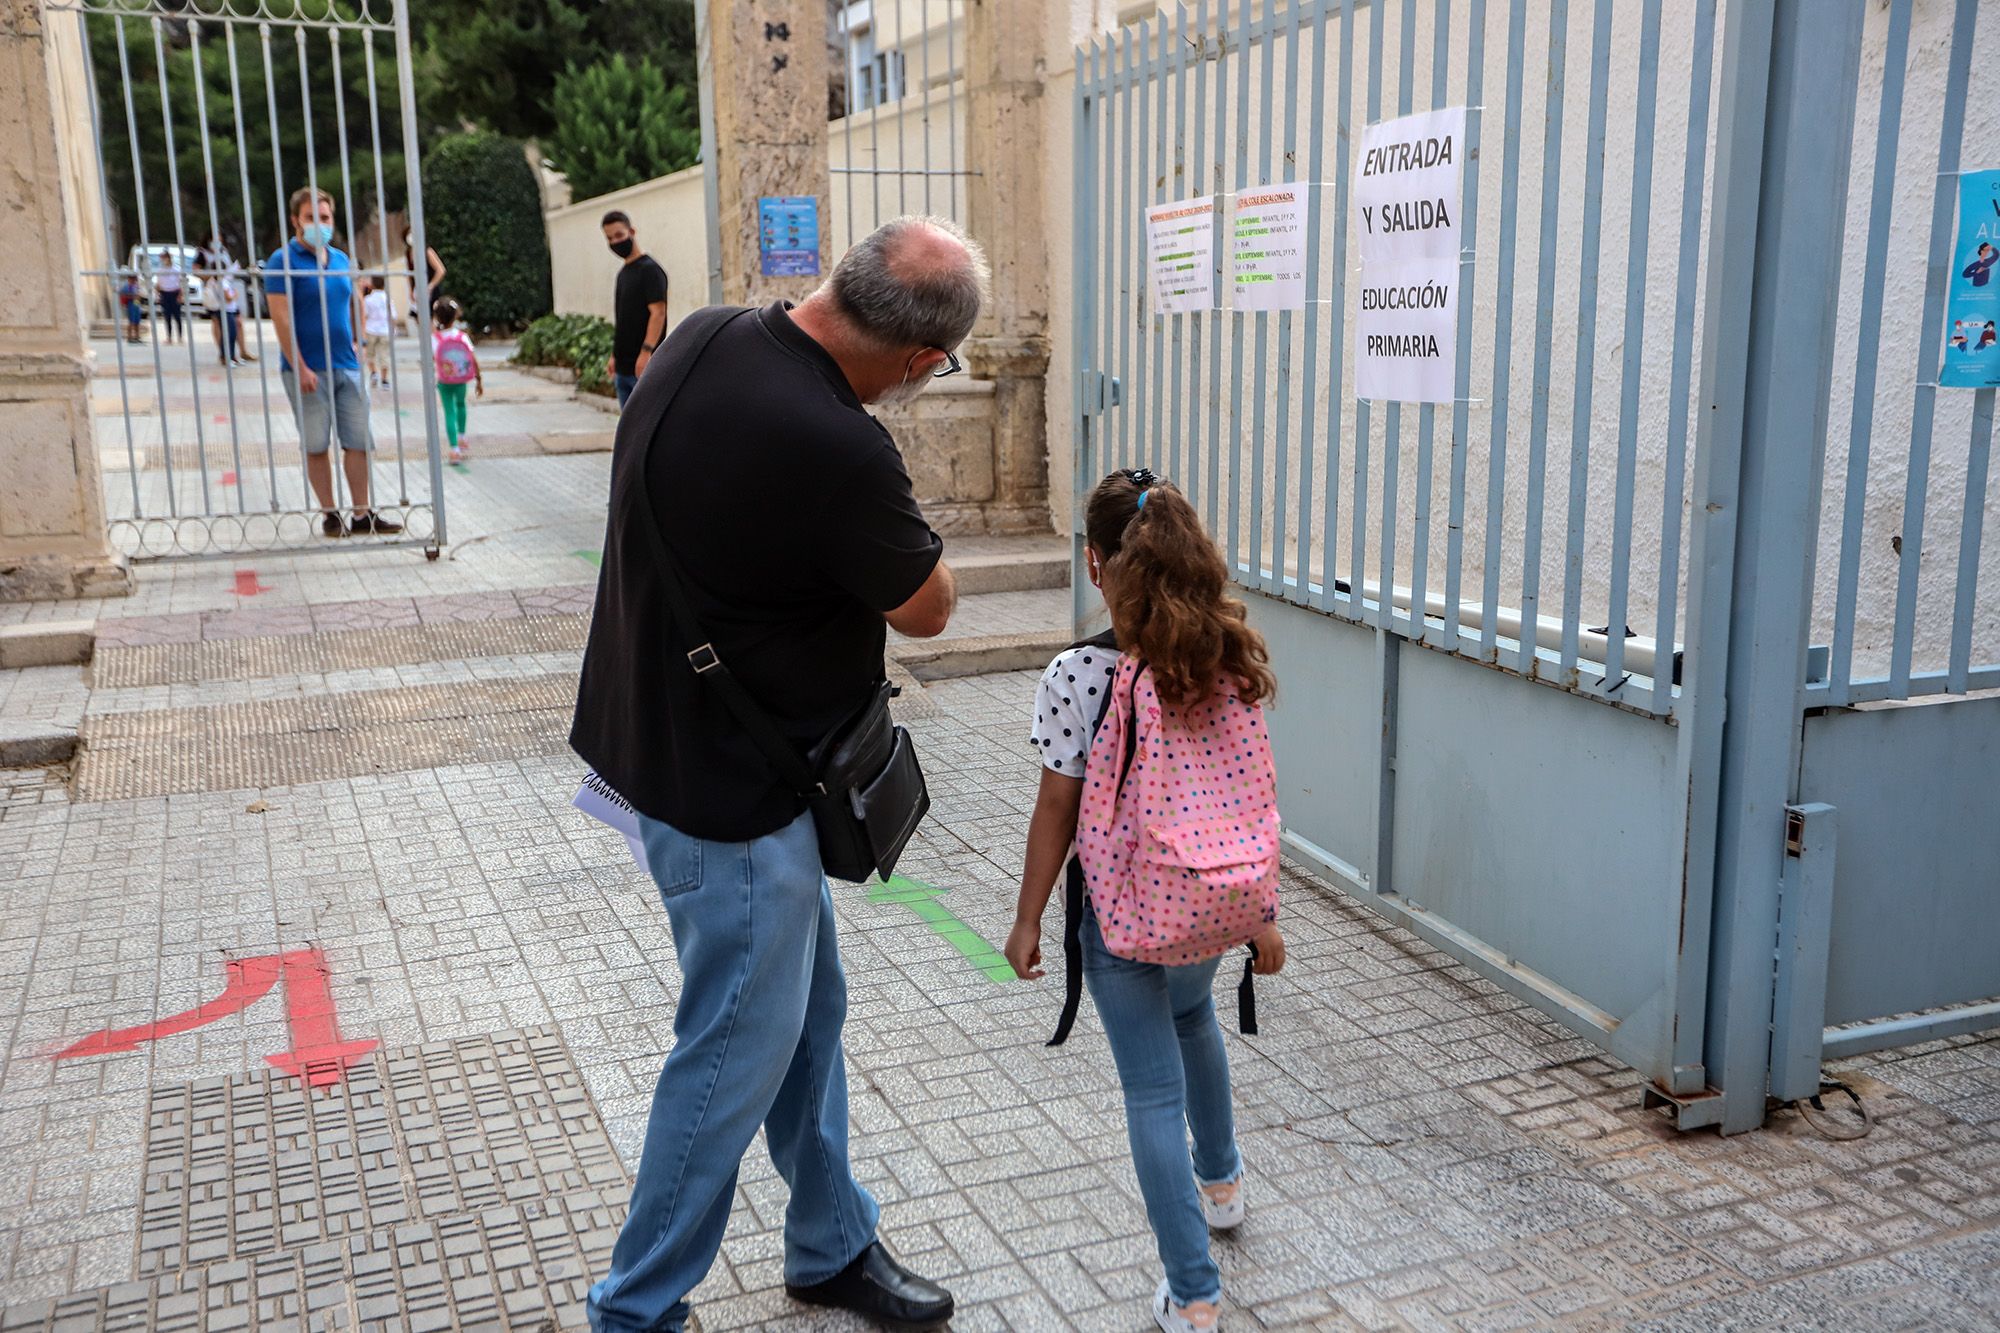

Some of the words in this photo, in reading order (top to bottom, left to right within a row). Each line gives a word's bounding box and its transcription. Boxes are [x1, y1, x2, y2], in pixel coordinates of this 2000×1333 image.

[1363, 135, 1452, 176] ENTRADA
[1363, 206, 1373, 234] Y
[1382, 198, 1451, 233] SALIDA
[1362, 279, 1448, 310] EDUCACIÓN
[1367, 335, 1440, 357] PRIMARIA
